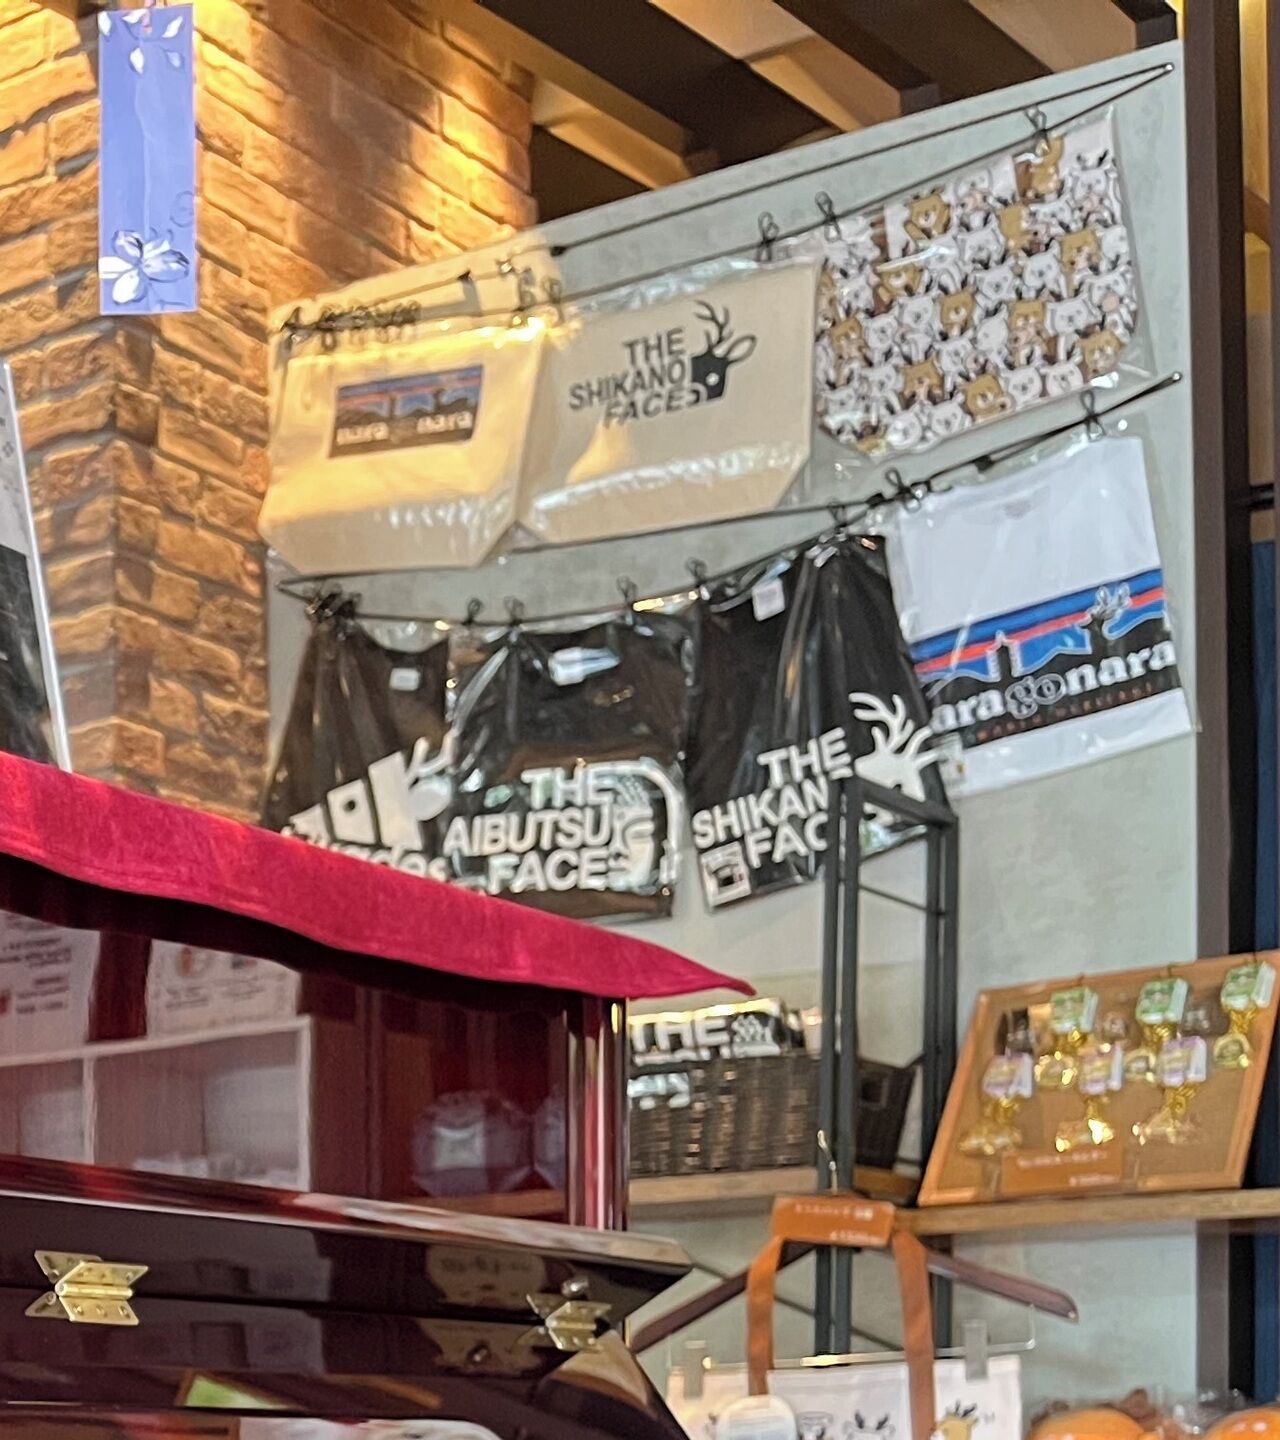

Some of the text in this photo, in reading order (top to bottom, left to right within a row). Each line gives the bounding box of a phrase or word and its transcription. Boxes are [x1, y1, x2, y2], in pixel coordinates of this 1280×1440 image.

[623, 327, 686, 367] THE
[568, 356, 687, 412] SHIKANO
[604, 387, 686, 428] FACE
[927, 640, 1177, 734] aragonara
[757, 726, 852, 790] THE
[520, 766, 615, 810] THE
[692, 768, 840, 850] SHIKAN
[442, 806, 614, 857] AIBUTSU
[744, 811, 829, 869] FAC
[488, 848, 614, 894] FACE
